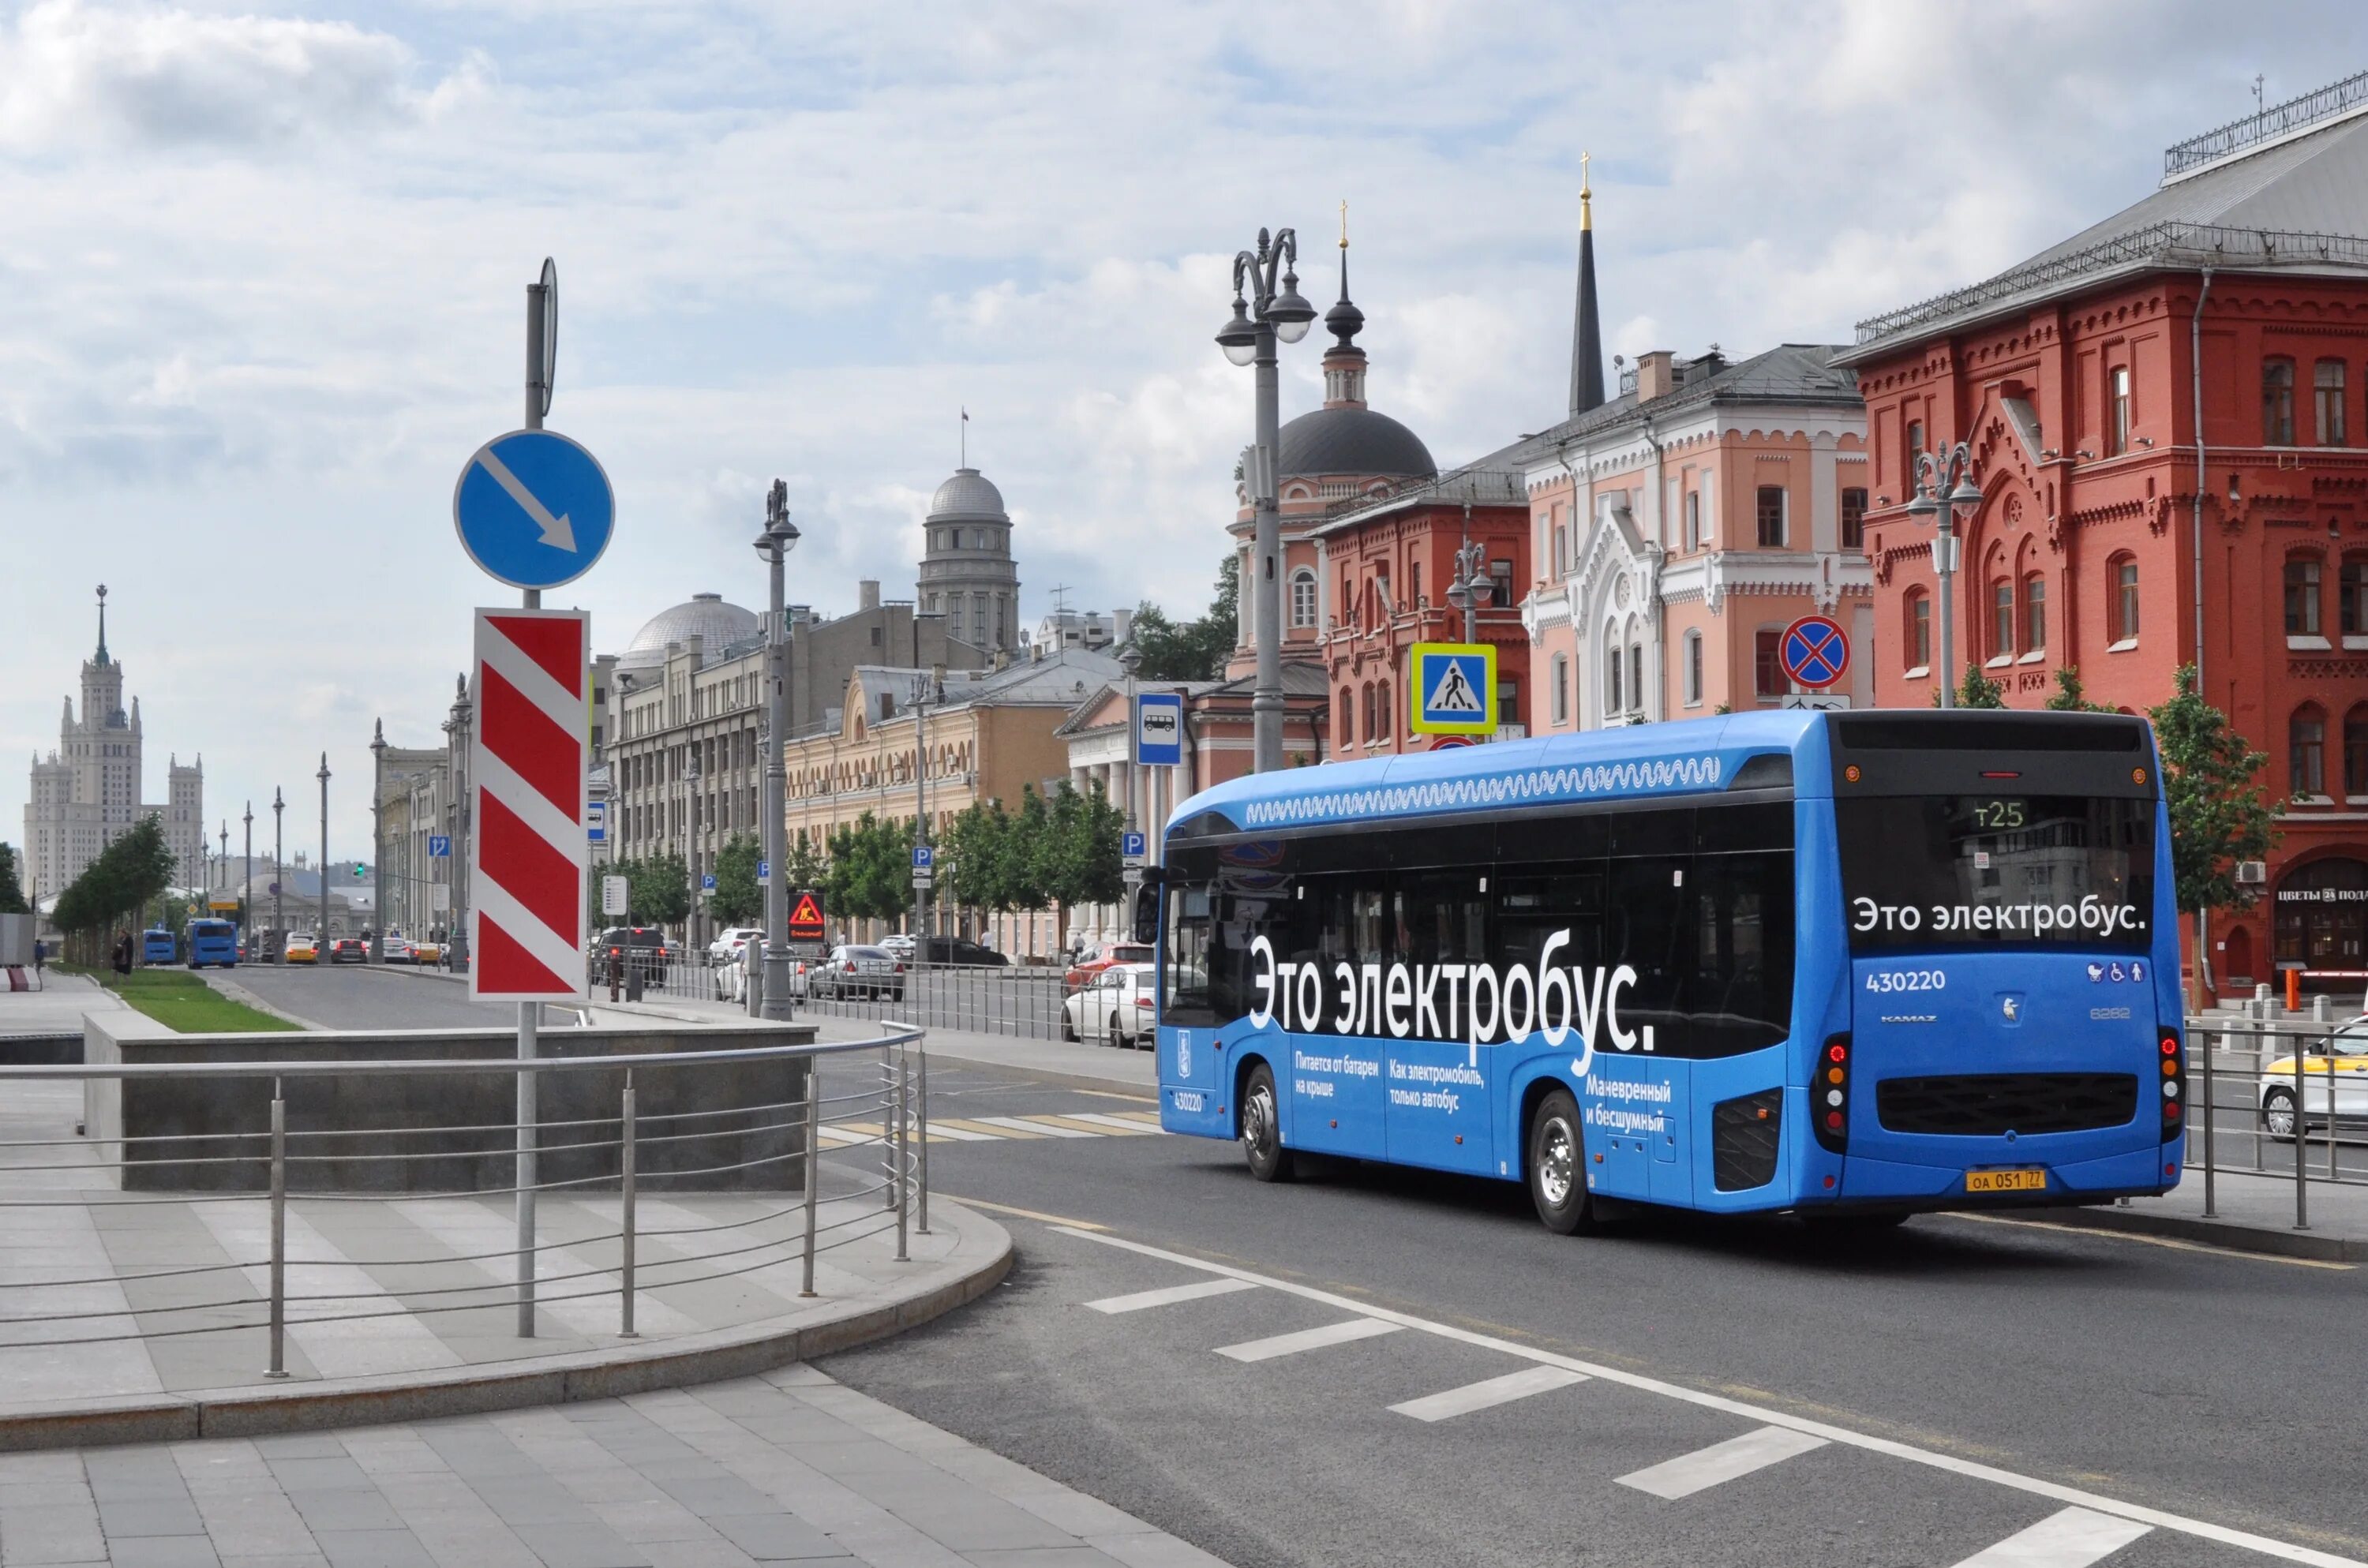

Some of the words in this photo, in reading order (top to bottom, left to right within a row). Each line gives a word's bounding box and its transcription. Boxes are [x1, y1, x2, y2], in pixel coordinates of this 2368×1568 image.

[1128, 835, 1141, 853] P
[917, 849, 928, 864] P
[705, 876, 713, 887] P
[2278, 890, 2321, 902] ЦВЕТЫ
[1853, 896, 1921, 931] Это
[1931, 894, 2146, 937] электробус.
[1866, 970, 1946, 993] 430220
[1249, 934, 1322, 1033] Это
[1335, 927, 1654, 1078] электробус.
[1295, 1050, 1332, 1073] Питается
[1332, 1058, 1343, 1073] от
[1343, 1053, 1379, 1080] батареи
[1389, 1058, 1407, 1080] Как
[1407, 1062, 1484, 1089] электромобиль,
[1295, 1079, 1305, 1094] на
[1306, 1080, 1334, 1099] крыше
[1586, 1073, 1671, 1104] Маневренный
[1175, 1091, 1202, 1113] 430220
[1390, 1089, 1420, 1106] только
[1422, 1088, 1459, 1114] автобус
[1586, 1108, 1594, 1125] и
[1595, 1102, 1665, 1134] бесшумный
[1973, 1177, 1990, 1189] ОА
[1995, 1173, 2021, 1188] 051
[2027, 1171, 2040, 1183] 77
